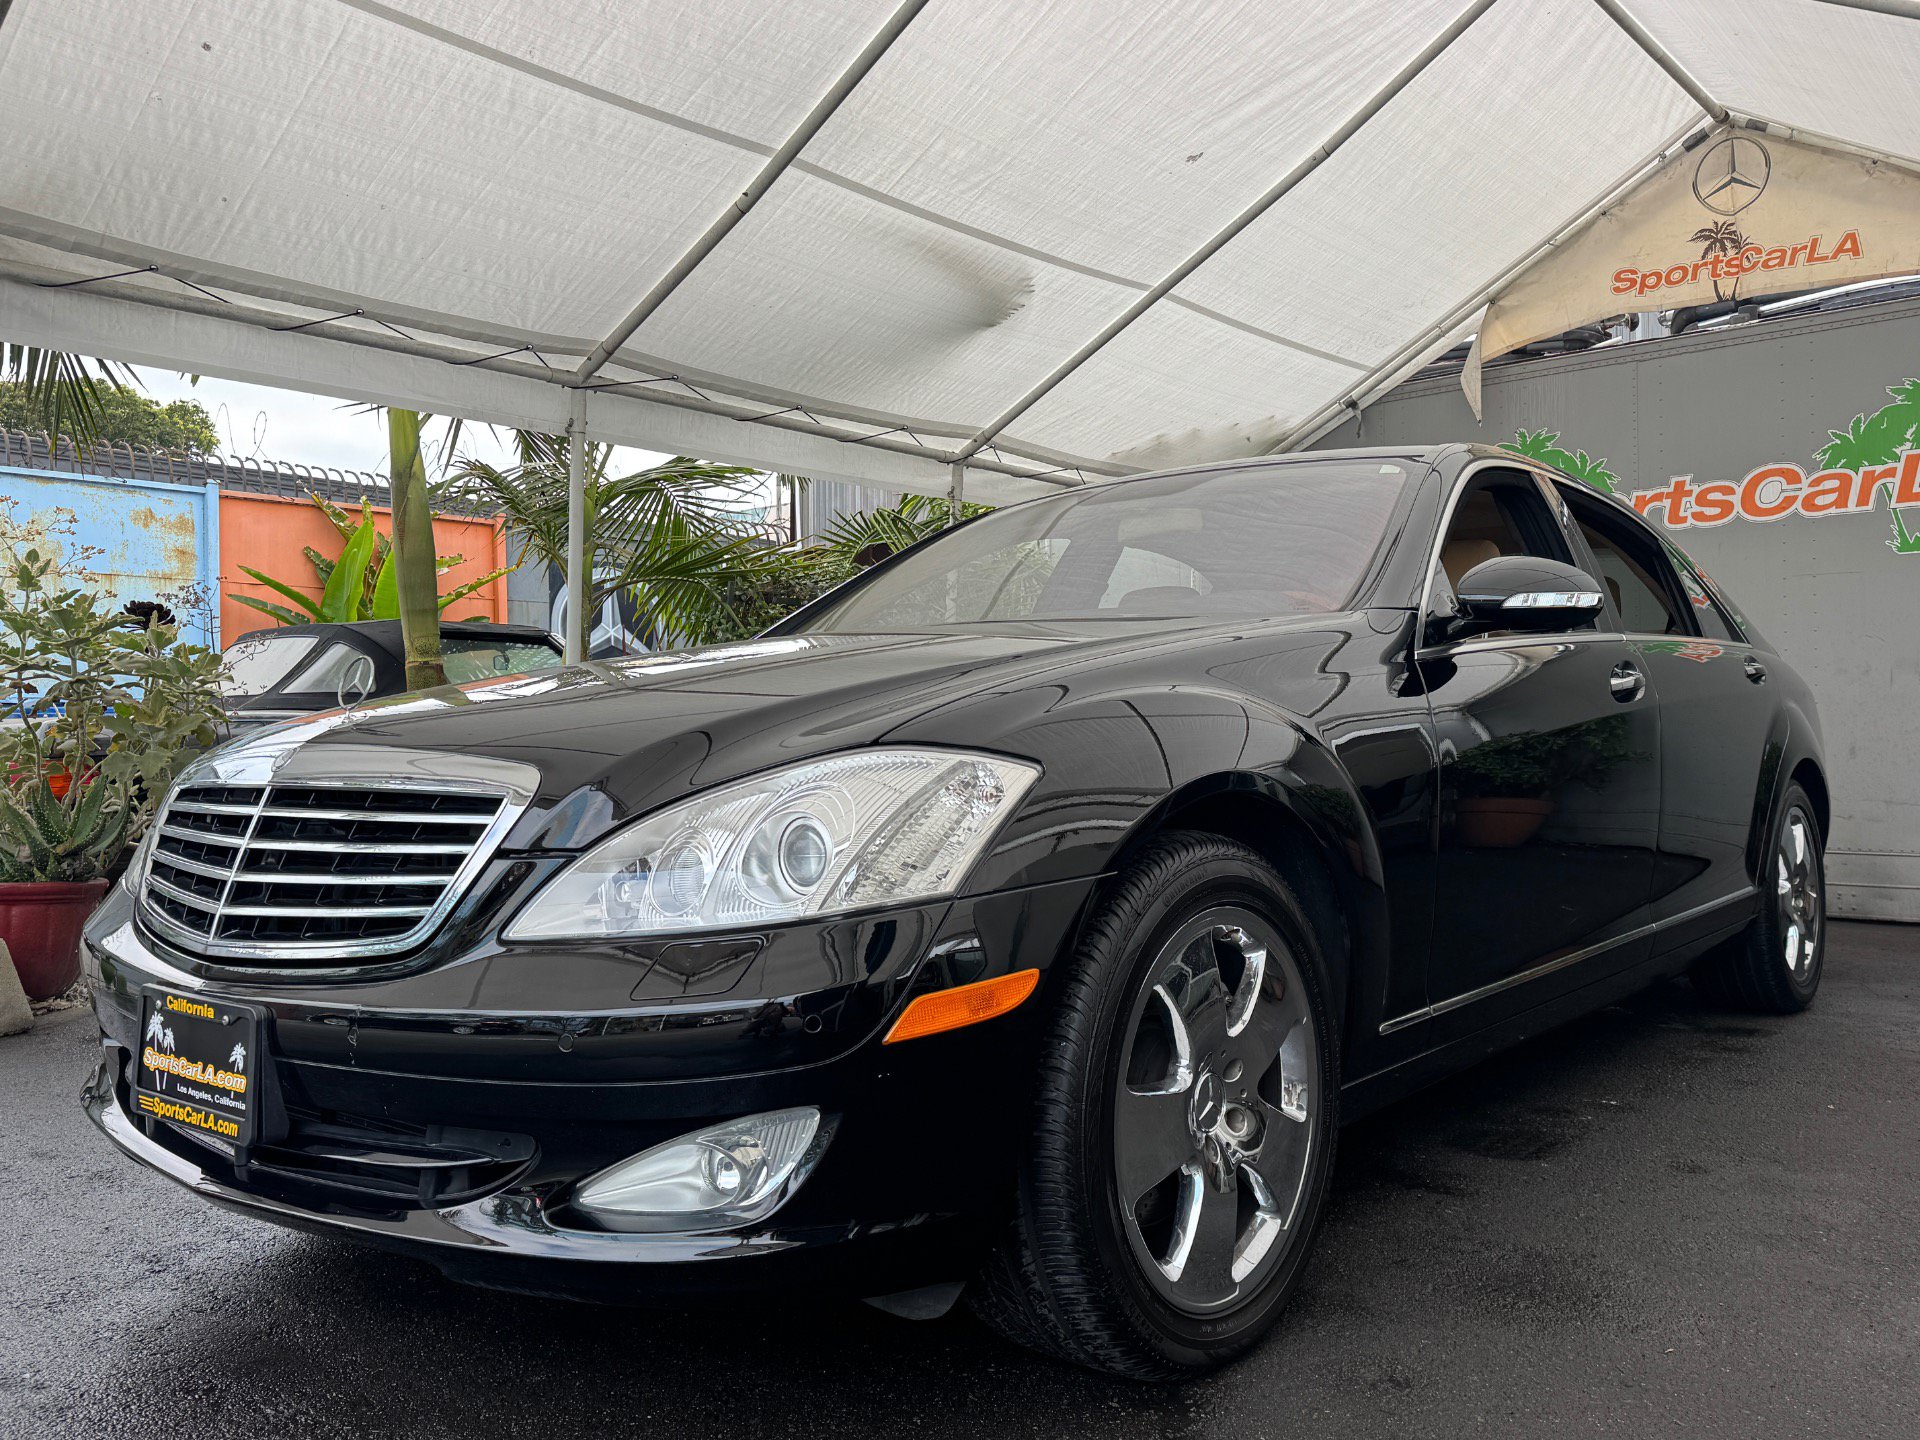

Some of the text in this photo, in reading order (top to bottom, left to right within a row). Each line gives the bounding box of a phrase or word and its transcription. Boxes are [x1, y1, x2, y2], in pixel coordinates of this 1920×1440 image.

[1611, 229, 1863, 297] SportsCarLA
[166, 995, 215, 1019] California
[143, 1047, 247, 1092] SportsCarLA.com
[176, 1083, 246, 1110] Los Angeles, California
[152, 1097, 239, 1137] SportsCarLA.com
